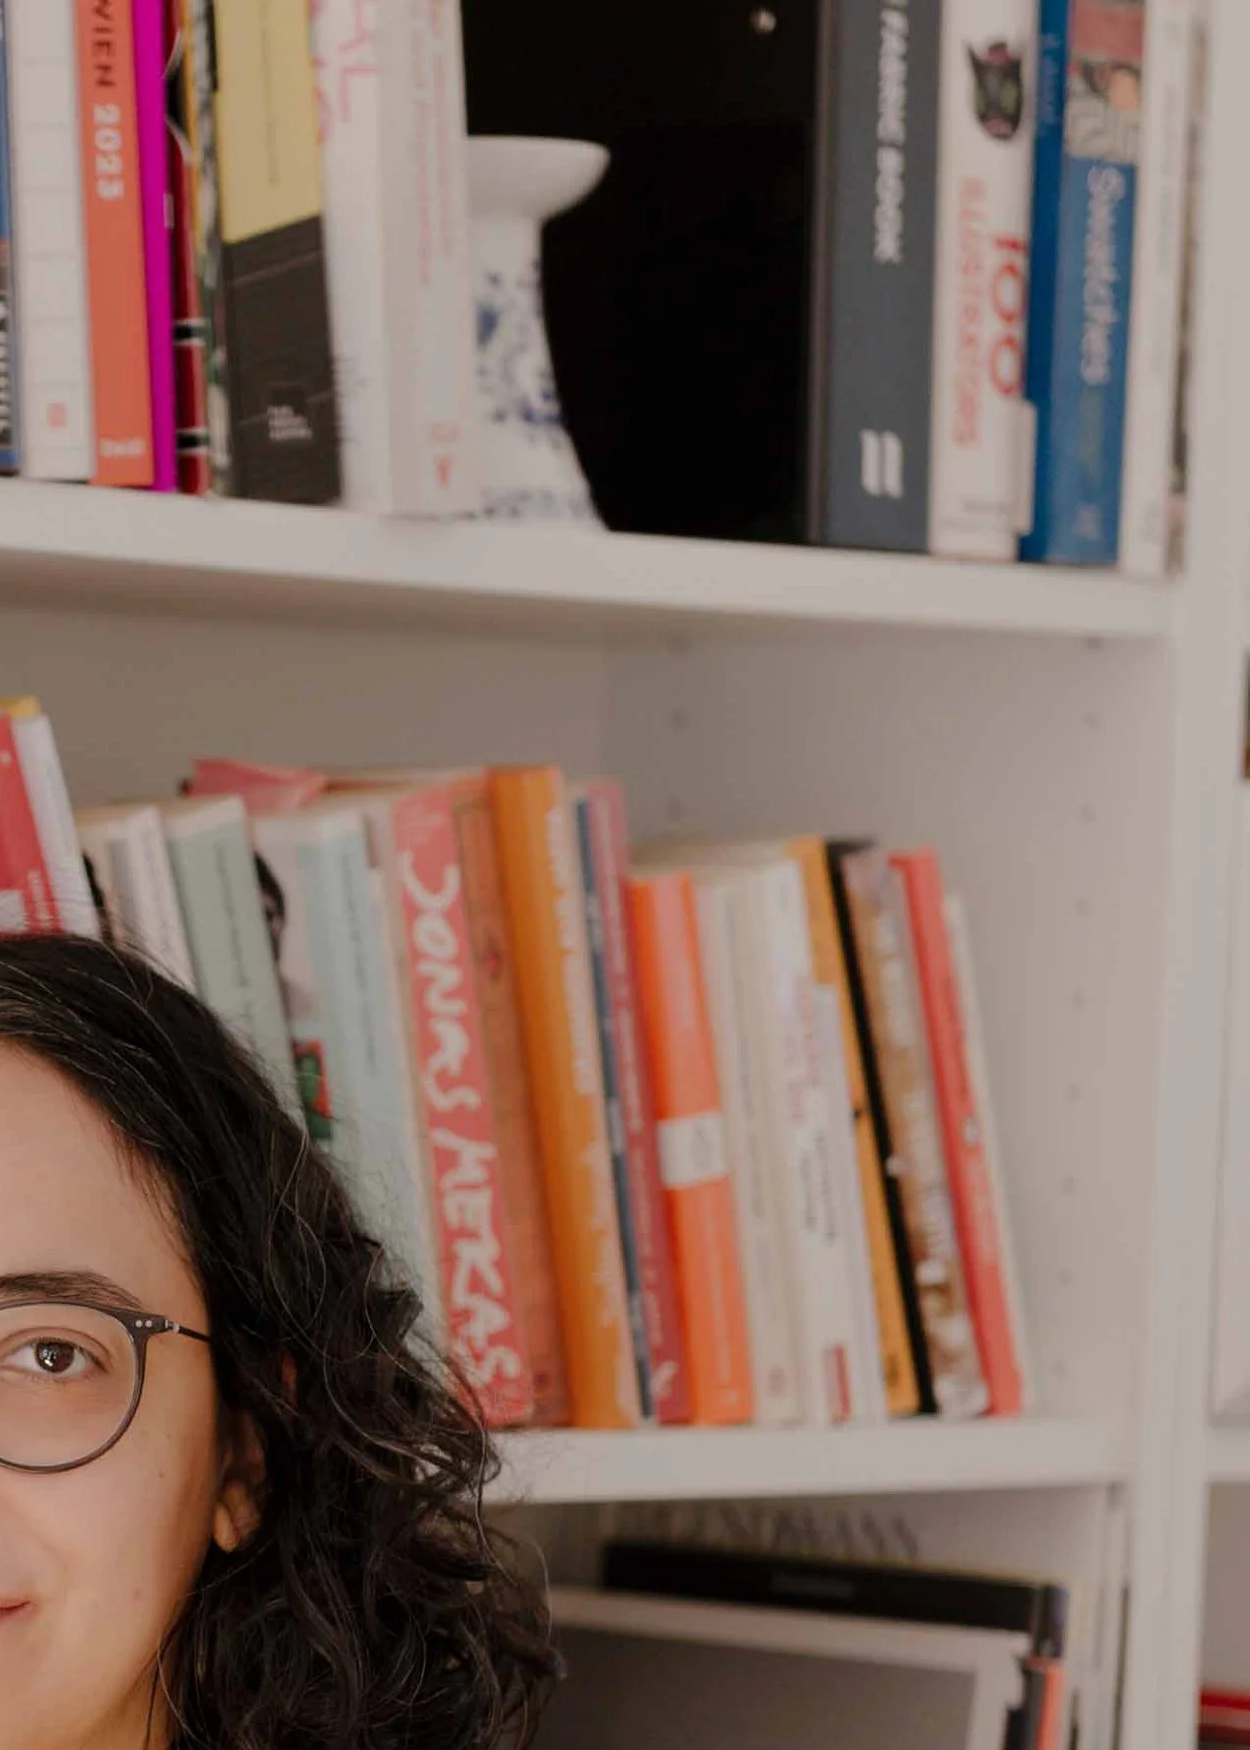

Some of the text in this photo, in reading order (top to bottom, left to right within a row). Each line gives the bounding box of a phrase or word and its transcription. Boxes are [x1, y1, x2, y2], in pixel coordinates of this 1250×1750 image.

[92, 104, 125, 199] 2023
[873, 148, 905, 265] BOOK
[1080, 166, 1125, 386] Swatches
[399, 851, 526, 1393] JONAS MEKAS
